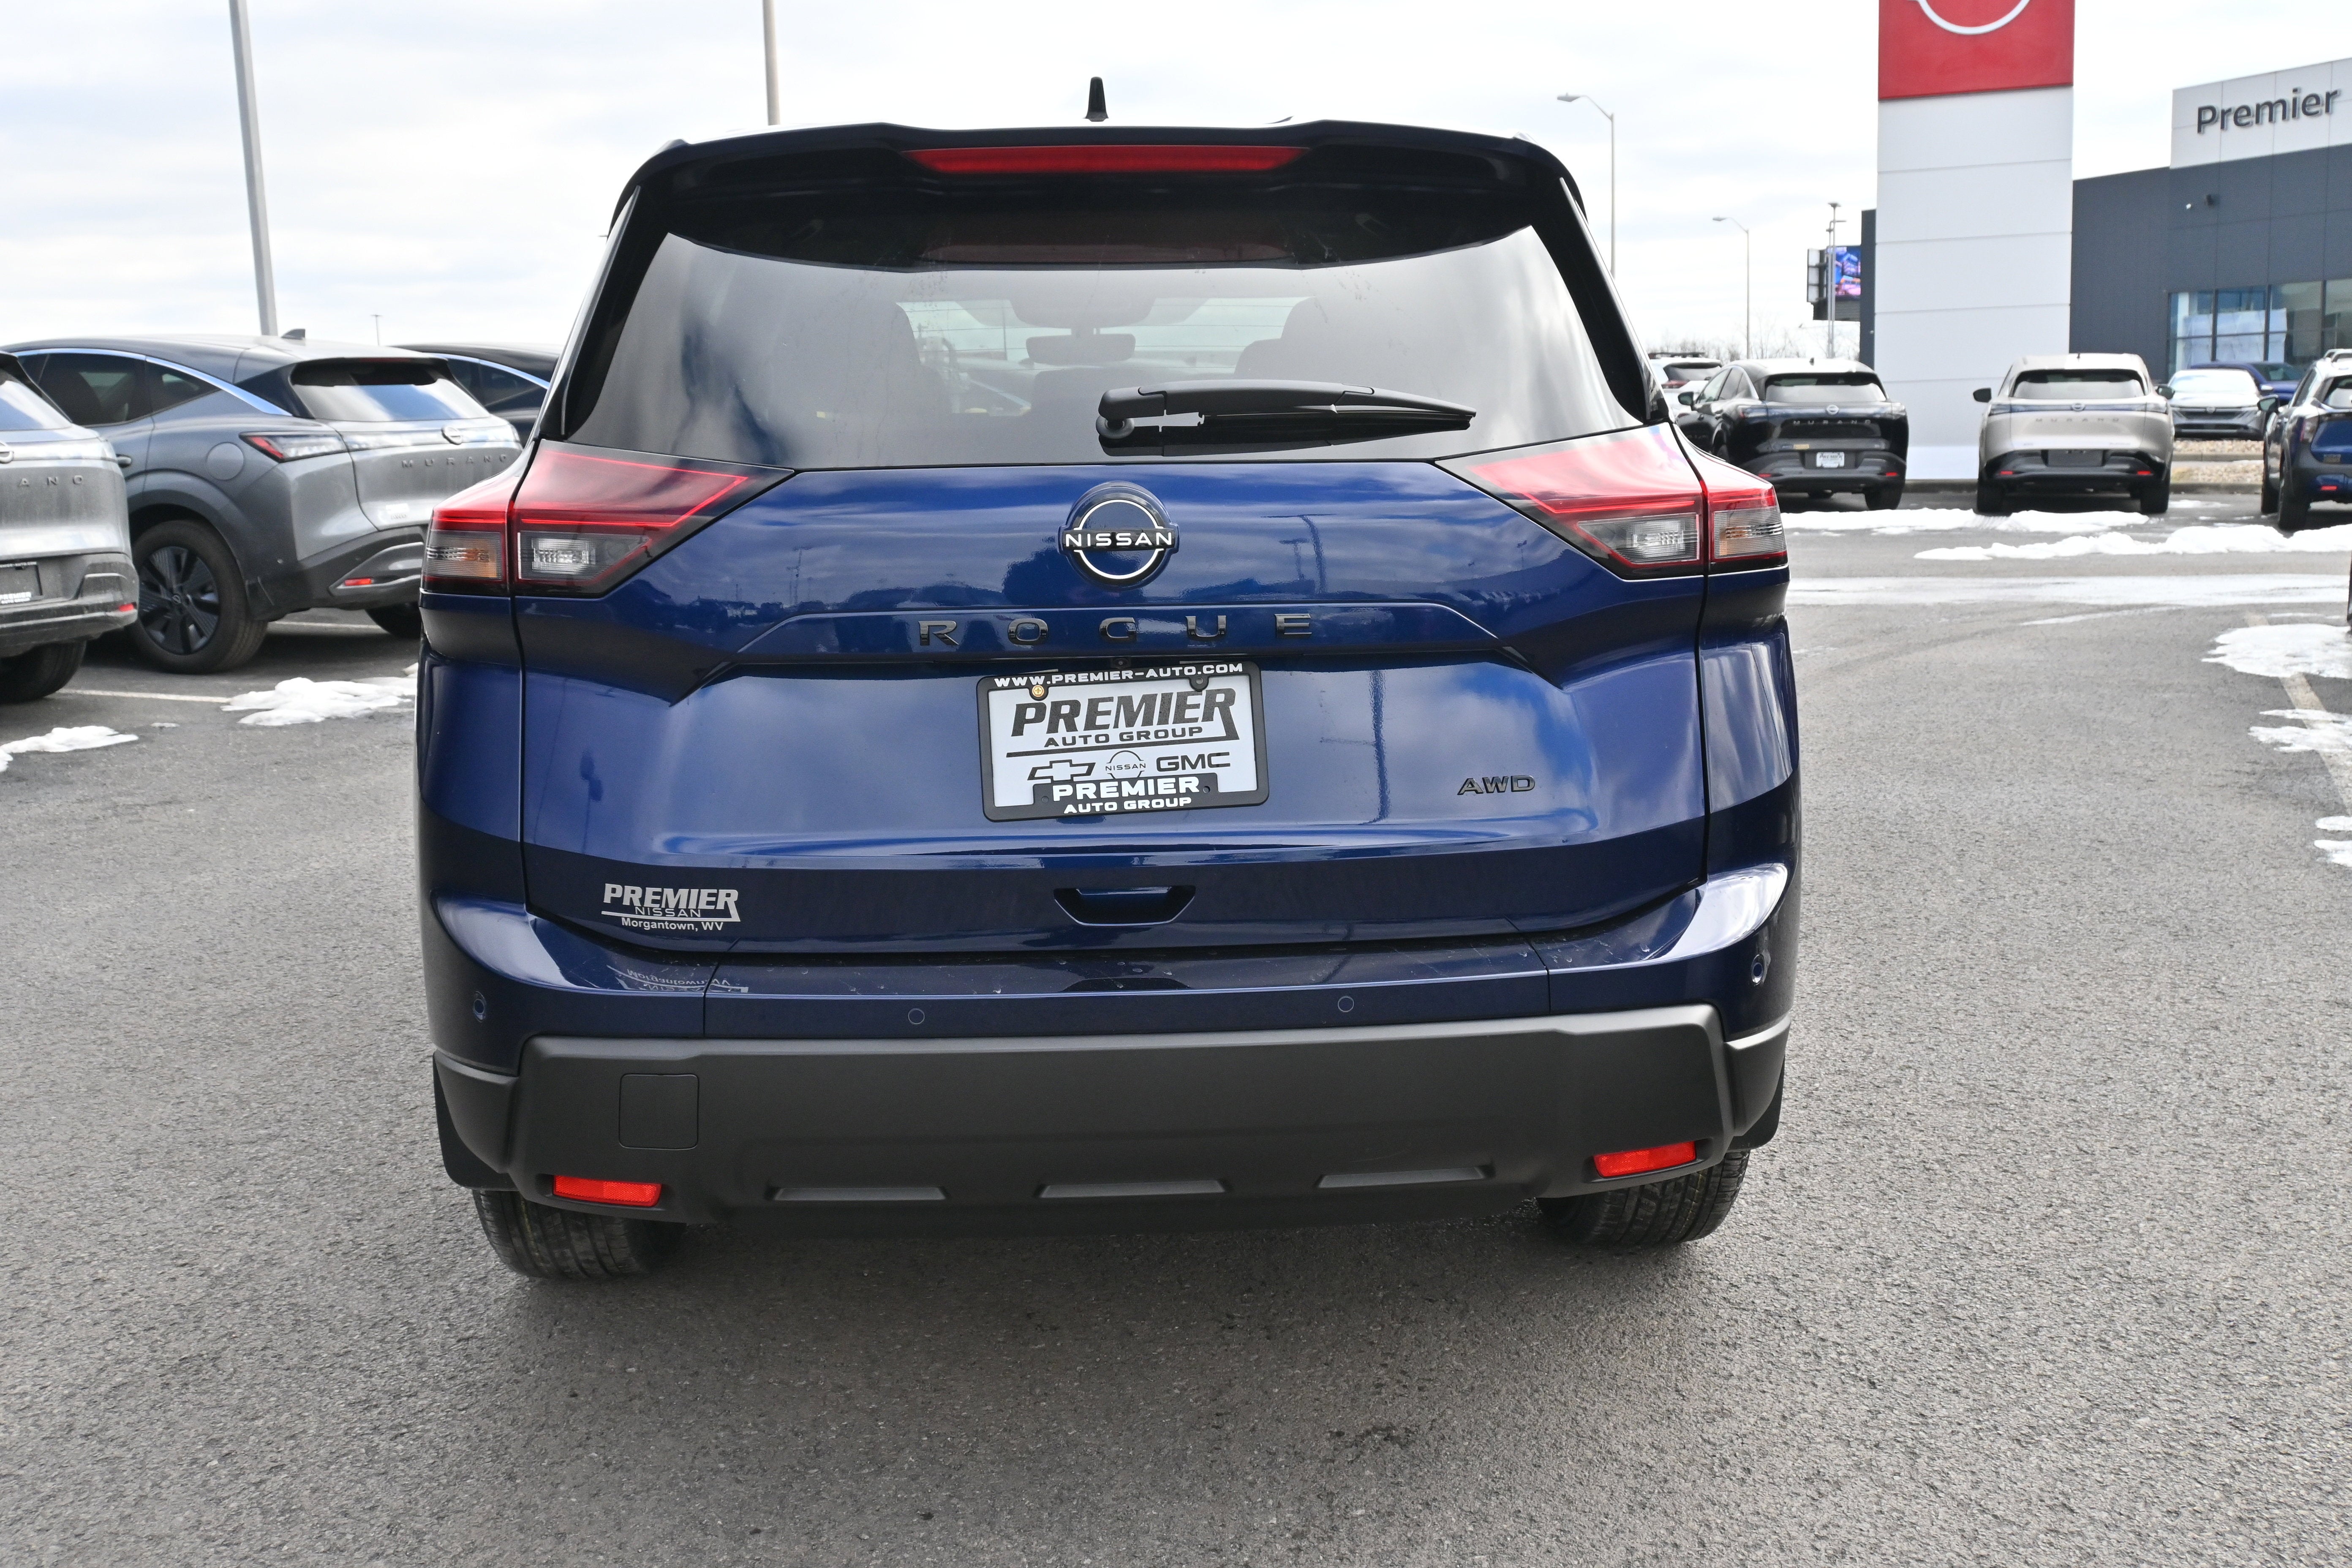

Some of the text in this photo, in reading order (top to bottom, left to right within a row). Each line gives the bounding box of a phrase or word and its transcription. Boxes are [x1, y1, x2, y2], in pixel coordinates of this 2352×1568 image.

[2197, 87, 2341, 134] Premier
[401, 454, 506, 468] MURANO
[1065, 531, 1173, 547] NISSAN
[919, 613, 1312, 646] ROGUE
[994, 663, 1243, 687] WWW.PREMIER-AUTO.COM
[1011, 688, 1240, 740] PREMIER
[1044, 726, 1203, 748] AUTO GROUP
[1105, 751, 1231, 772] NISSAN GMC
[1053, 776, 1200, 802] PREMIER
[1457, 775, 1535, 795] AWD
[1064, 797, 1192, 814] AUTO GROUP
[603, 883, 740, 918] PREMIER
[635, 906, 701, 917] NISSAN
[622, 917, 724, 931] Morgantown, WV
